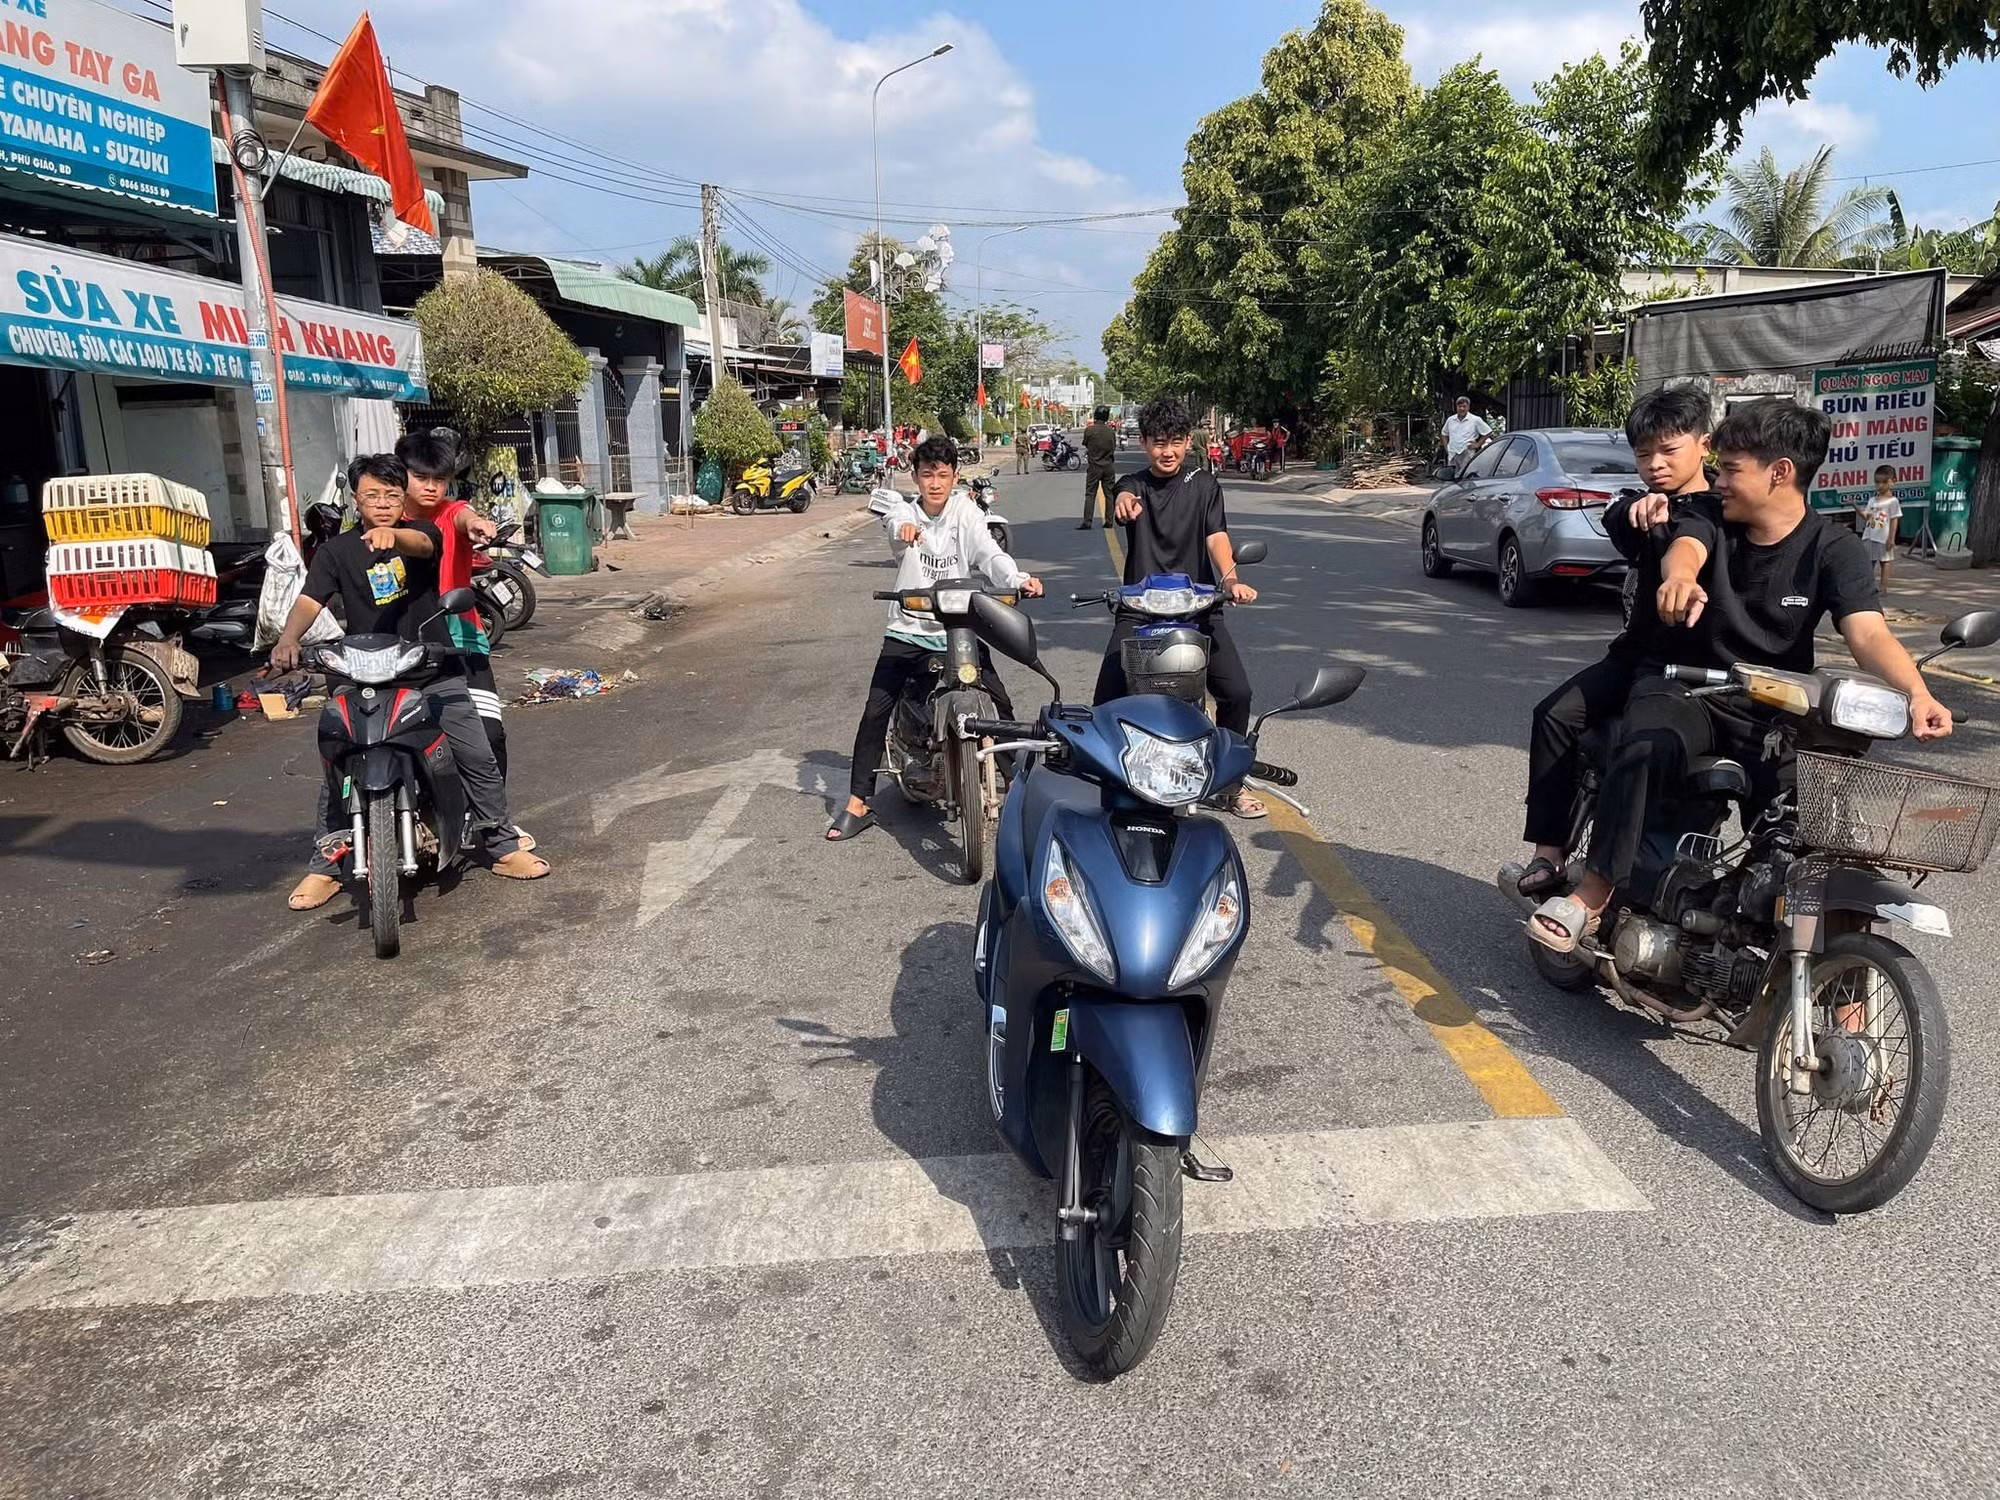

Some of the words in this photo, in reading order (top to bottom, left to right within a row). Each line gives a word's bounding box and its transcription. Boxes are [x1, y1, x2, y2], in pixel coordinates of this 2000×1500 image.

[0, 20, 56, 66] NG
[65, 41, 113, 85] TAY
[123, 63, 161, 102] GA
[12, 81, 92, 123] CHUYÊN
[98, 105, 166, 145] NGHIỆP
[0, 110, 87, 154] YAMAHA
[106, 139, 169, 175] SUZUKI
[59, 164, 72, 175] BD
[119, 178, 139, 190] 0866
[16, 265, 122, 326] SỬA
[122, 289, 182, 335] XE
[199, 301, 295, 352] MIH
[299, 320, 396, 366] KHANG
[8, 325, 79, 359] CHUYÊN:
[79, 328, 111, 363] SỬA
[114, 335, 138, 367] CÁC
[137, 343, 169, 375] LOẠI
[170, 346, 187, 373] XE
[187, 342, 203, 374] SỐ
[212, 353, 228, 376] XE
[228, 355, 245, 379] GA
[1820, 372, 1860, 393] QUÁN
[1861, 370, 1900, 389] NGỌC
[1903, 368, 1930, 384] MAI
[1822, 394, 1867, 415] BÚN
[1875, 389, 1927, 411] RIÊU
[1831, 419, 1860, 439] ÚN
[1866, 415, 1928, 437] MĂNG
[1829, 440, 1858, 463] HỦ
[1866, 437, 1915, 460] TIẾU
[1818, 468, 1868, 488] BÁNH
[920, 552, 958, 569] mirates
[1126, 825, 1166, 835] HONDA
